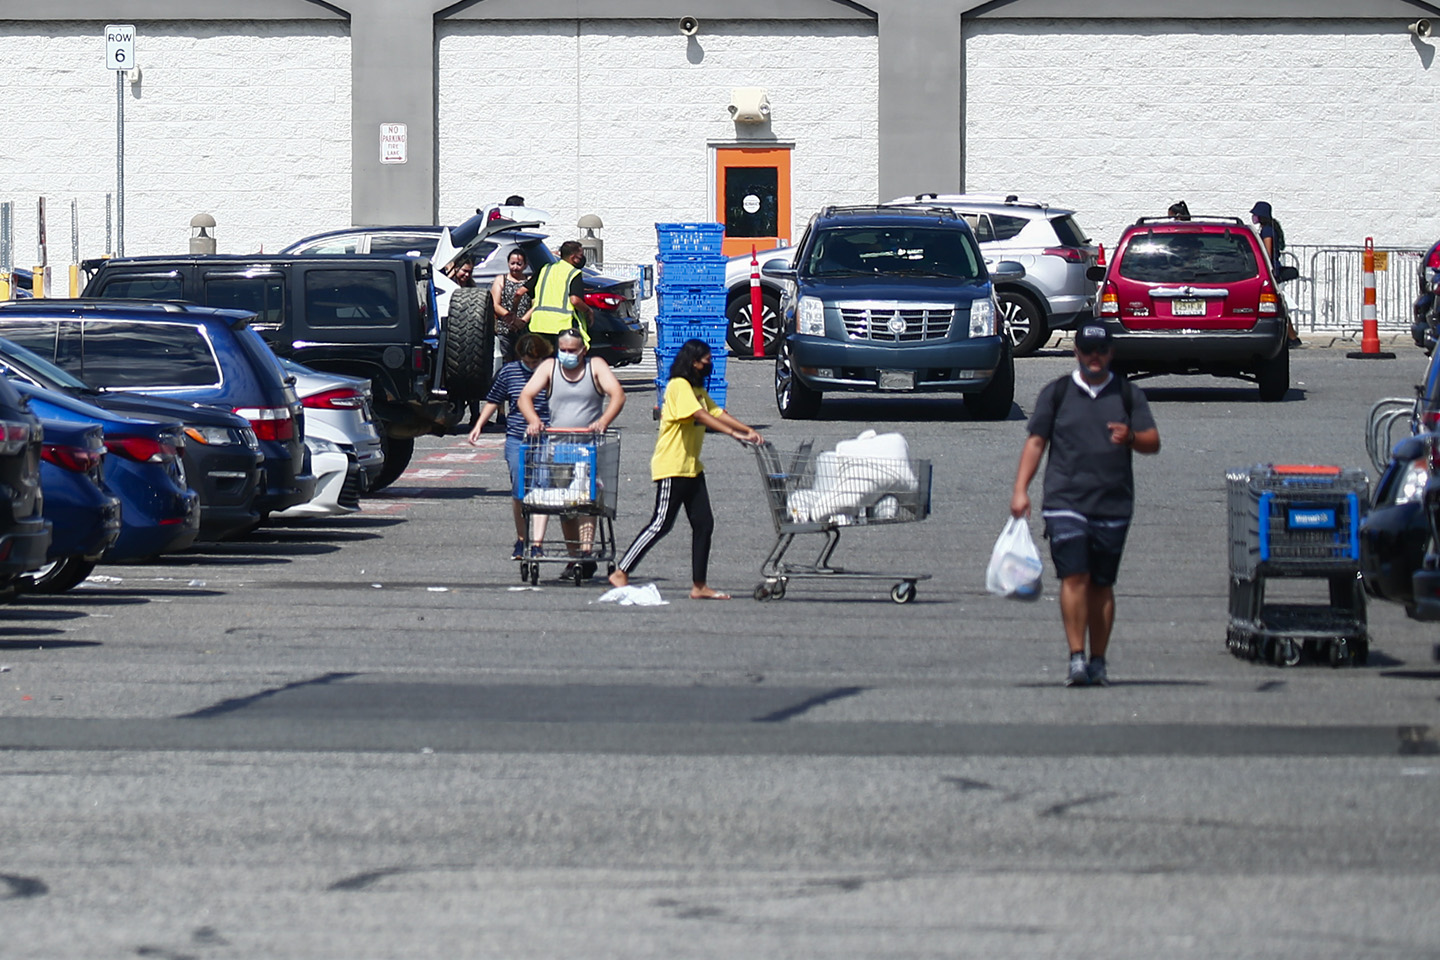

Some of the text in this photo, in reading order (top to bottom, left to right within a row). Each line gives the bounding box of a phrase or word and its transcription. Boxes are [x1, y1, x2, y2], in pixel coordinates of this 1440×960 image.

[108, 33, 133, 42] ROW
[115, 48, 126, 63] 6
[388, 126, 399, 134] NO
